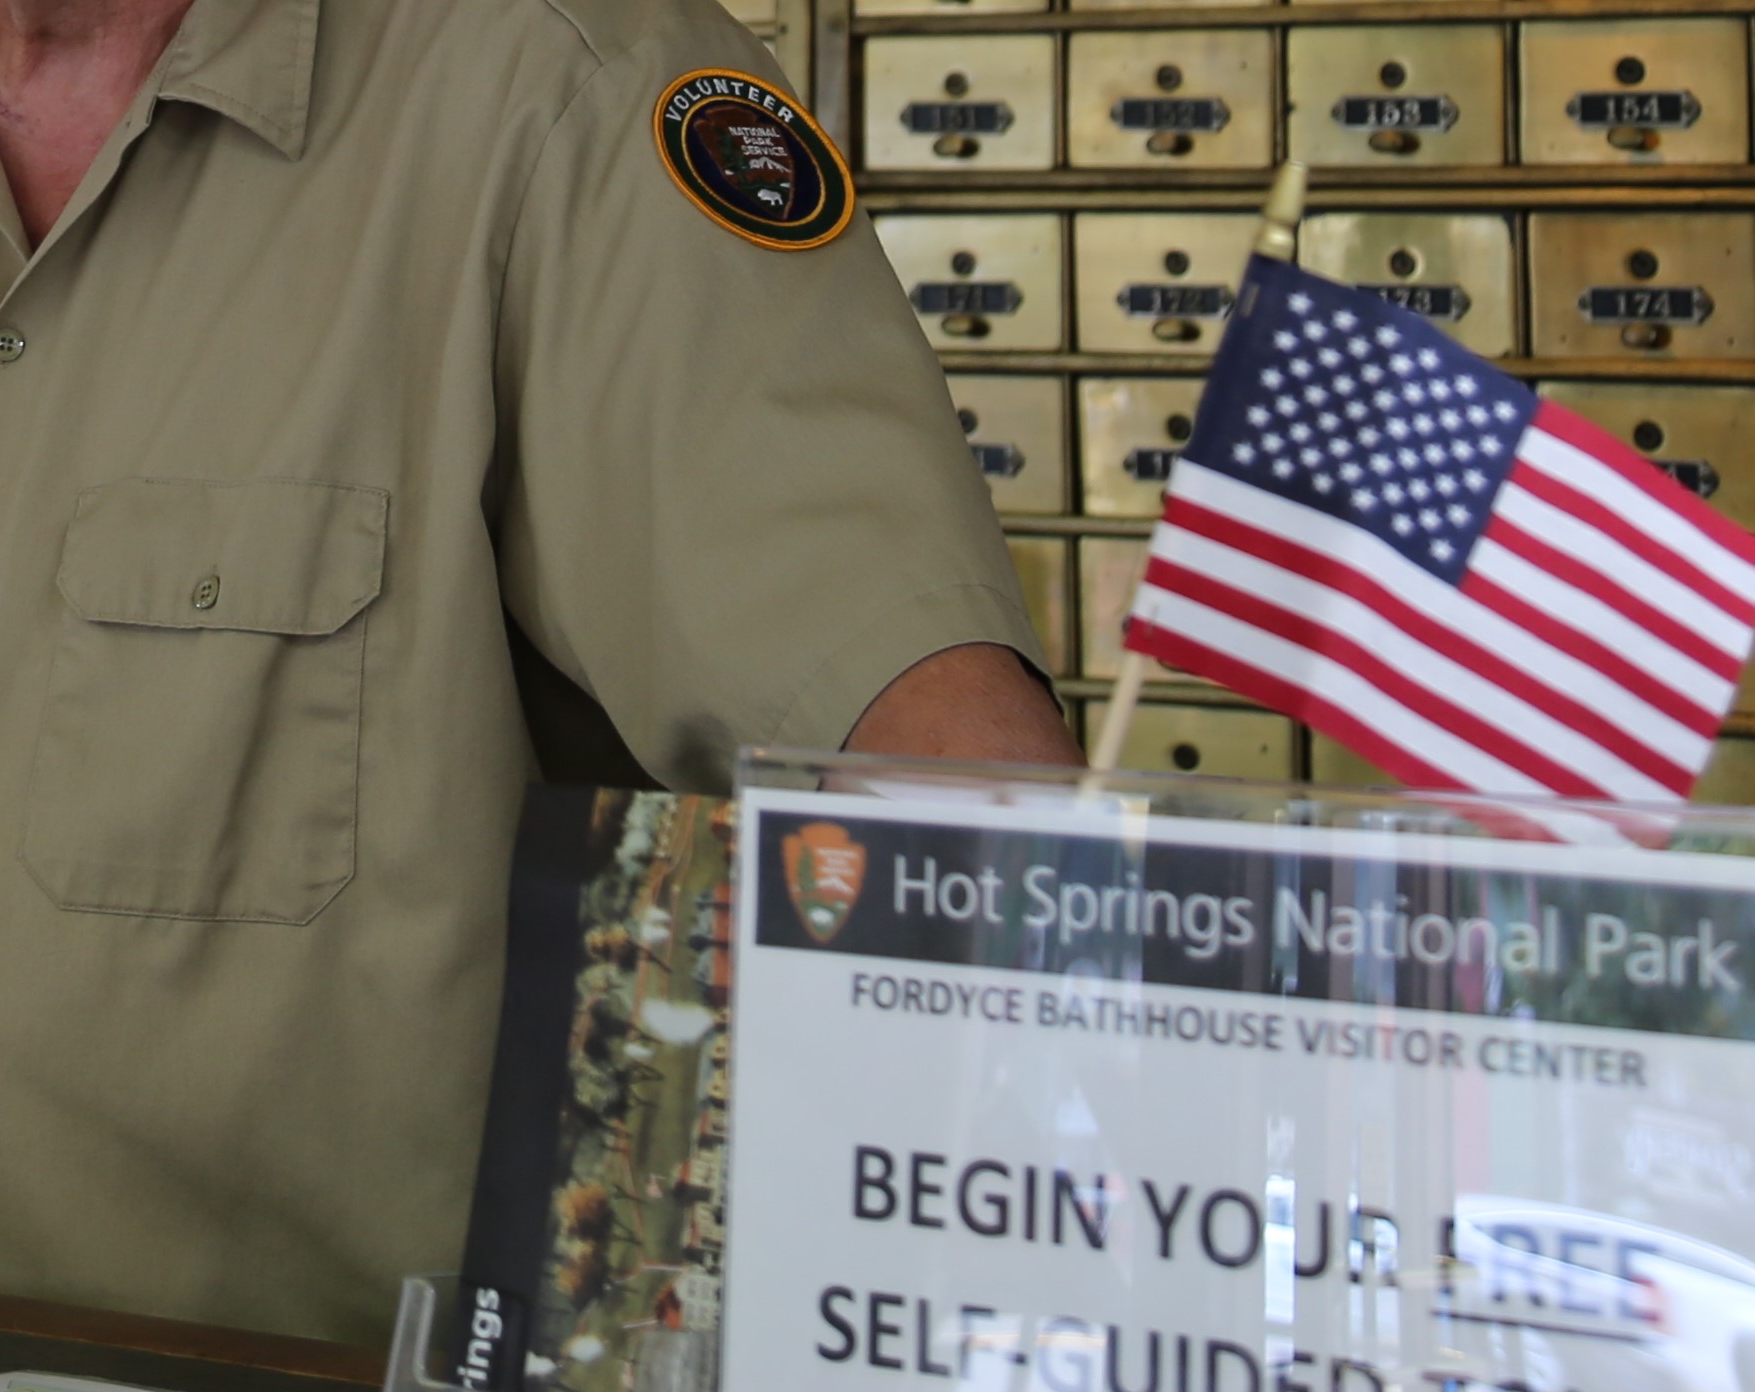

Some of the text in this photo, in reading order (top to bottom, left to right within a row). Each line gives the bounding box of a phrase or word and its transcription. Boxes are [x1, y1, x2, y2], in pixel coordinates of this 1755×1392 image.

[665, 78, 794, 123] VOLUNTEER
[1366, 99, 1421, 125] 153
[1605, 96, 1660, 122] 154
[729, 126, 781, 138] NATIONAL
[743, 136, 774, 146] PARK
[741, 145, 788, 157] SERVICE
[1616, 292, 1672, 317] 174
[893, 853, 1741, 992] Hot Springs National Park
[851, 973, 1648, 1087] FORDYCE BATHHOUSE VISITOR CENTER
[853, 1145, 1107, 1251] BEGIN
[1141, 1177, 1400, 1288] YOUR
